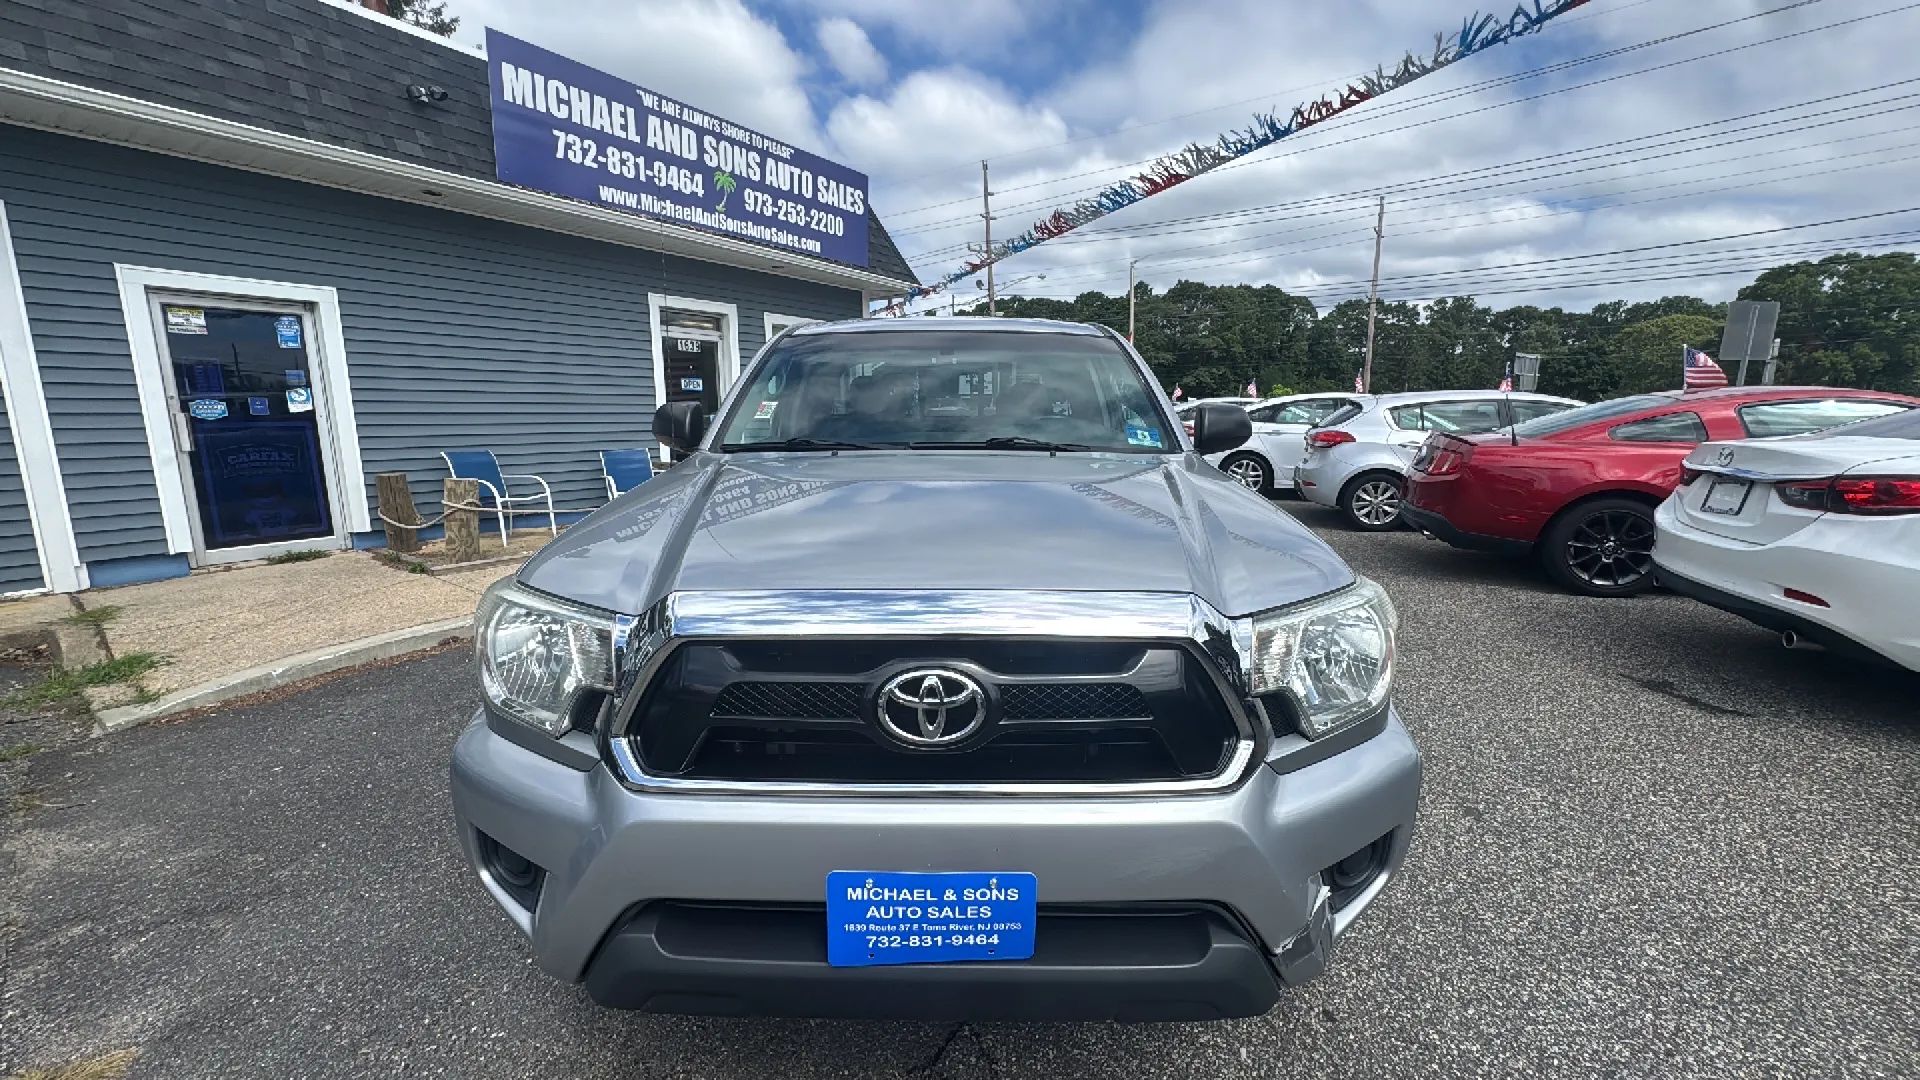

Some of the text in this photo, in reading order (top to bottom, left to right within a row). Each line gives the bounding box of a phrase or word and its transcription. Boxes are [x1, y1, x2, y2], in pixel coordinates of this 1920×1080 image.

[502, 61, 865, 215] MICHAEL AND SONS AUTO SALES
[661, 99, 681, 119] ARE
[682, 108, 721, 132] ALWAYS
[722, 122, 750, 144] SHORE
[752, 134, 763, 148] TO
[552, 128, 704, 197] 732-831-9464
[599, 185, 821, 252] www.MichaelAndSonsAutoSales.com
[744, 188, 844, 237] 973-253-2200
[684, 380, 700, 389] OPEN
[847, 887, 1019, 901] MICHAEL & SONS
[866, 906, 992, 919] AUTO SALES
[869, 923, 896, 932] Route
[899, 923, 910, 931] 37
[978, 923, 991, 931] NJ
[866, 933, 1000, 948] 732-831-9464
